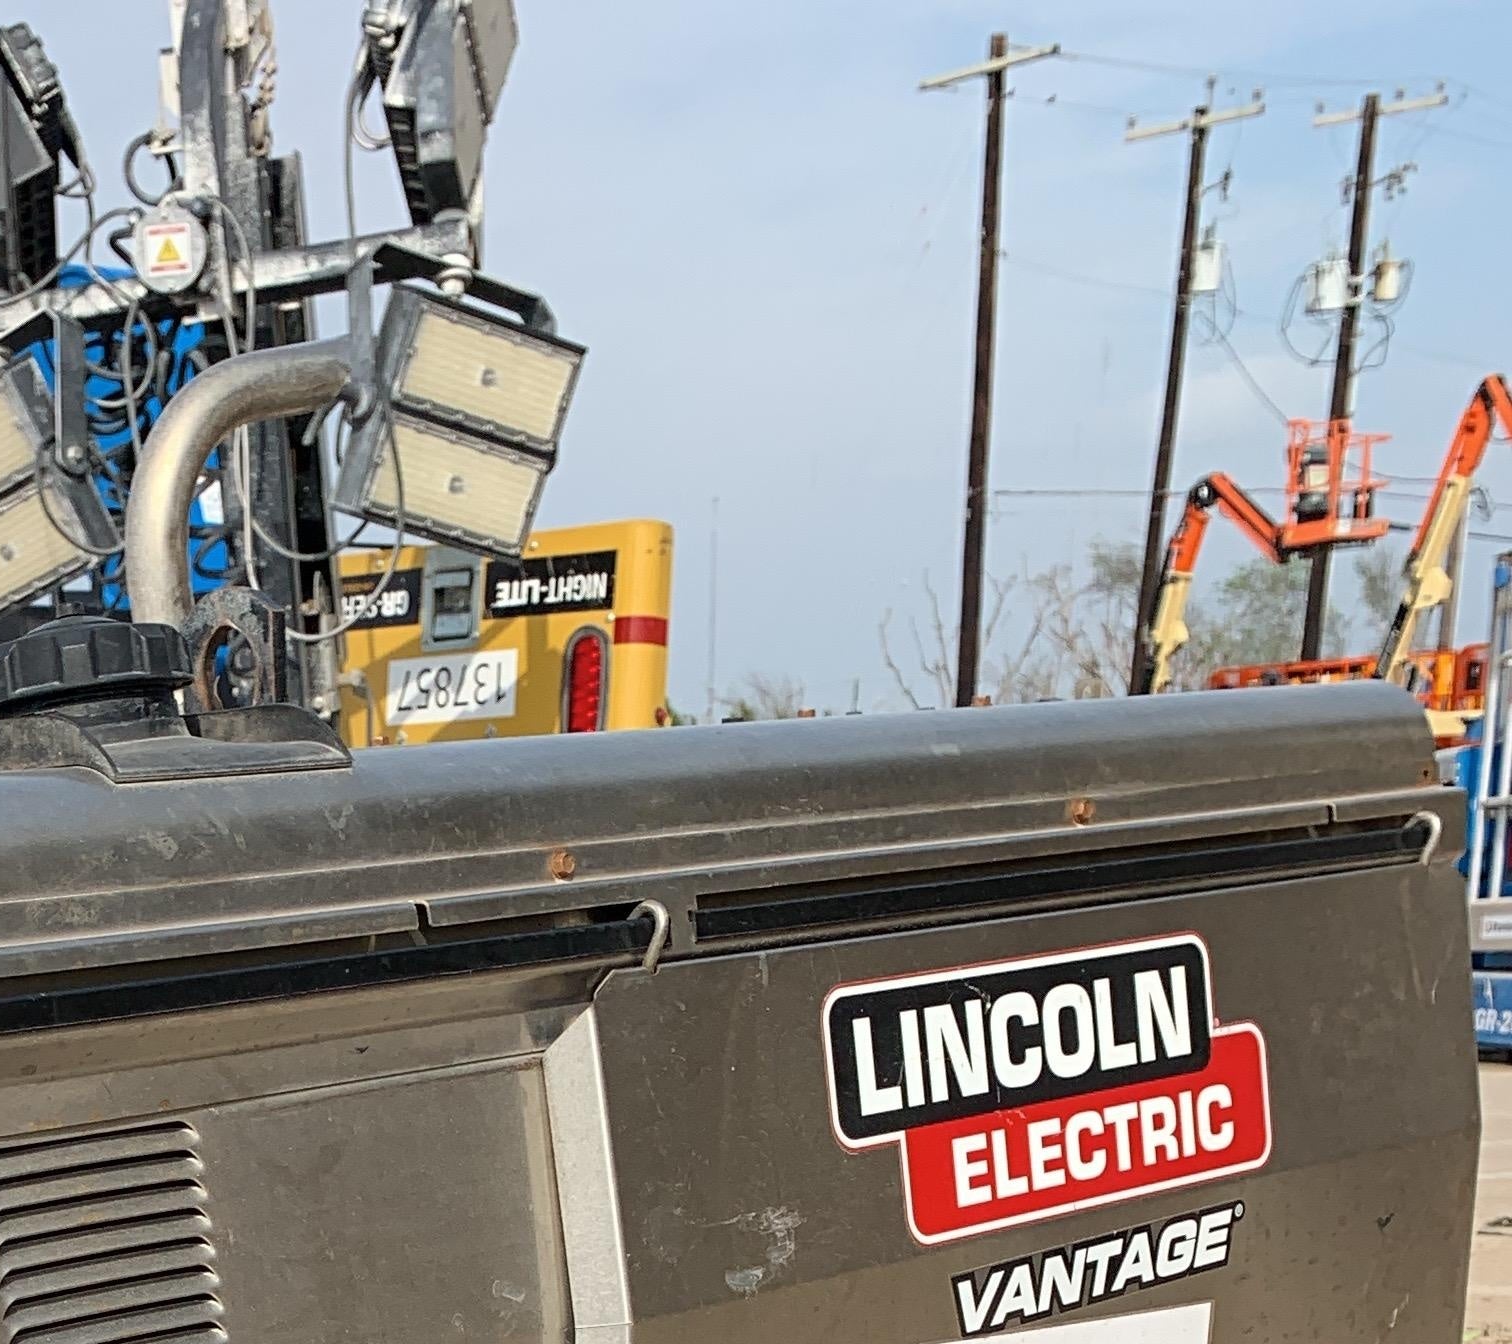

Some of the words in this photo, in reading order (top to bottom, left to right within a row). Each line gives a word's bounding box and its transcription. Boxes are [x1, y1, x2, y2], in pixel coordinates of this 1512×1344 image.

[491, 572, 609, 608] NIGHT-LITE
[397, 661, 508, 713] 137857
[852, 964, 1192, 1118] LINCOLN
[949, 1083, 1236, 1211] ELECTRIC
[956, 1216, 1233, 1336] VANTAGE
